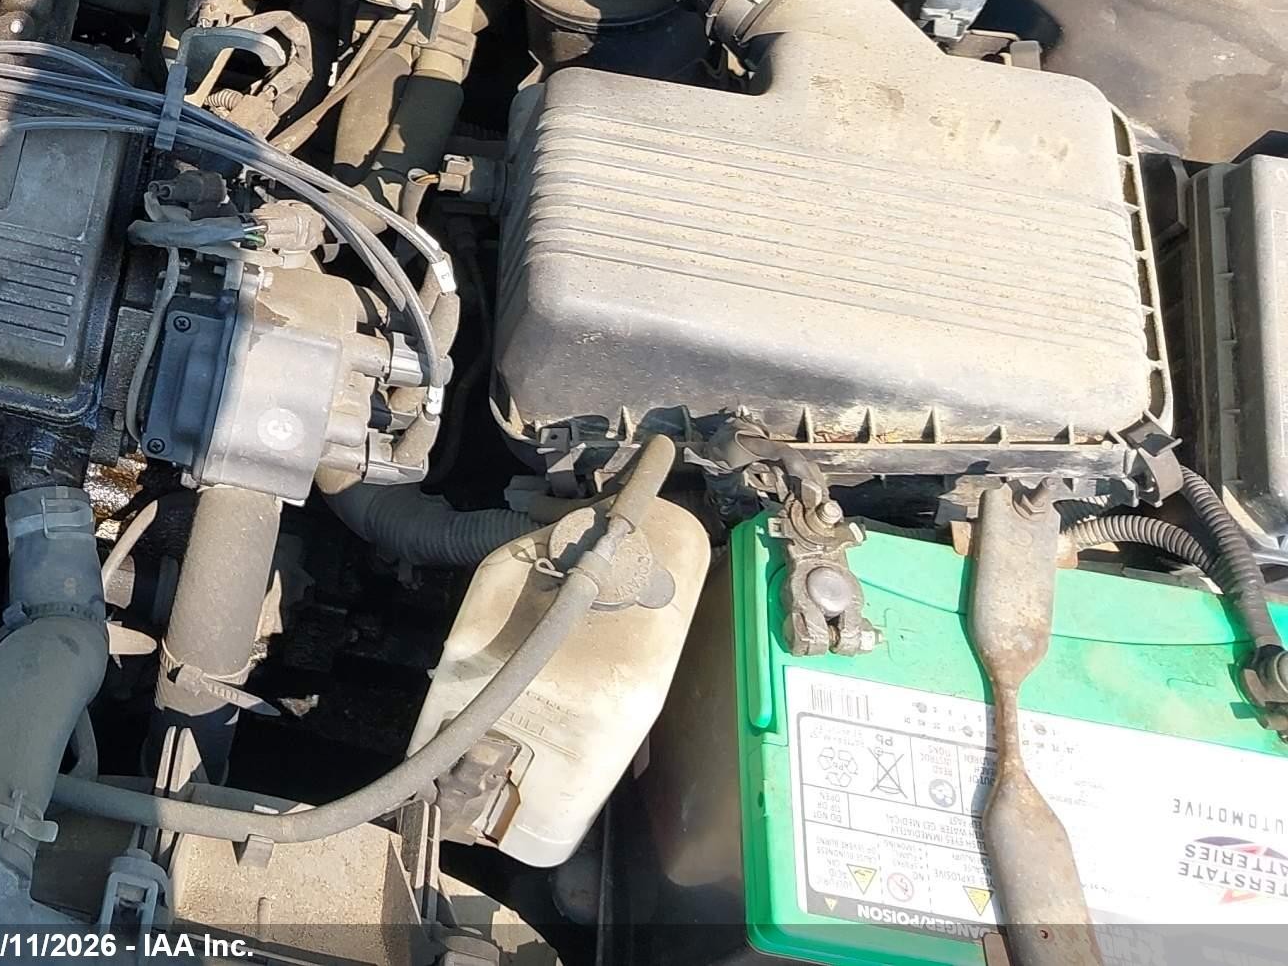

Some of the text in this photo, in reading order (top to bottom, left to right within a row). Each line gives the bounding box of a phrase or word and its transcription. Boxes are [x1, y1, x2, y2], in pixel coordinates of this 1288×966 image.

[875, 733, 893, 747] Pb
[891, 825, 943, 844] IMMEDIATELY
[939, 824, 966, 838] WATER
